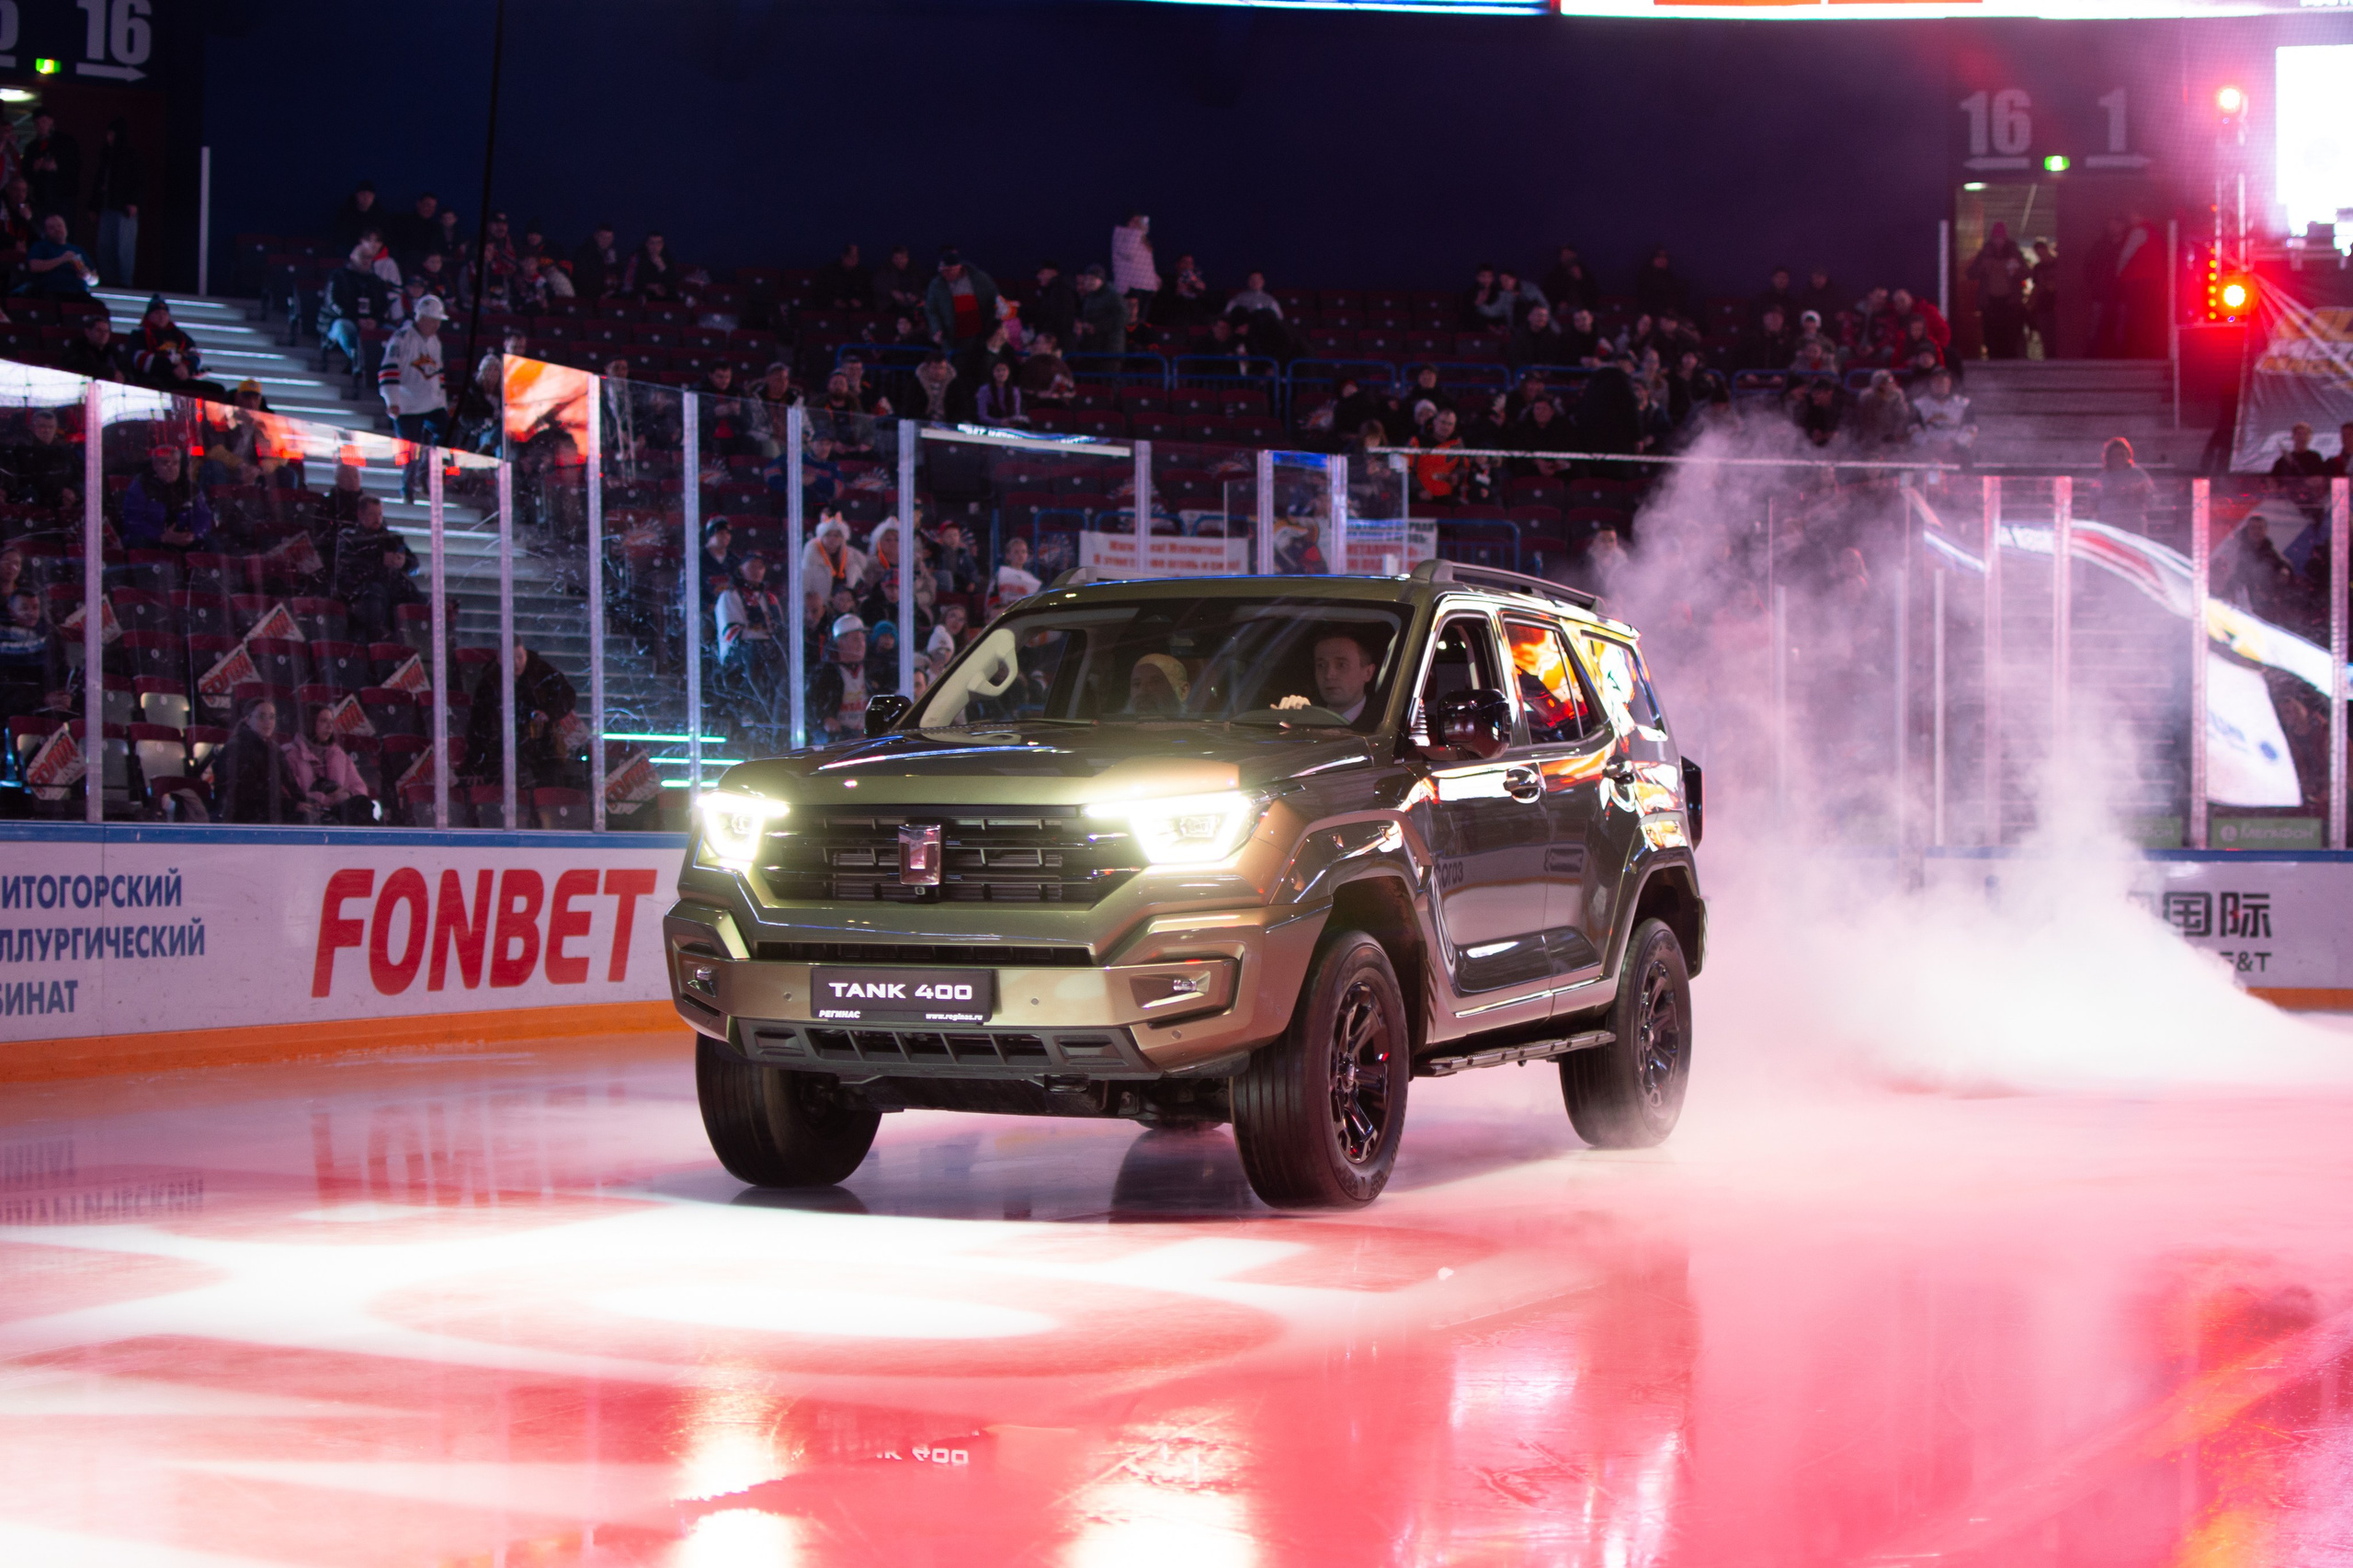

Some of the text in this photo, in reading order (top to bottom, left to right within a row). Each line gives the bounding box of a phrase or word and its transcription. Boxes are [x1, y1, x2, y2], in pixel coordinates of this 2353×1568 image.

[76, 0, 153, 65] 16
[1959, 89, 2031, 154] 16
[2097, 89, 2127, 153] 1
[2, 867, 182, 909] ИТОГОРСКИЙ
[311, 867, 657, 998] FONBET
[0, 979, 78, 1017] ИНАТ
[828, 983, 972, 1000] TANK 400
[818, 1009, 861, 1019] РЕГИНАС
[926, 1013, 983, 1021] www.reginas.ru
